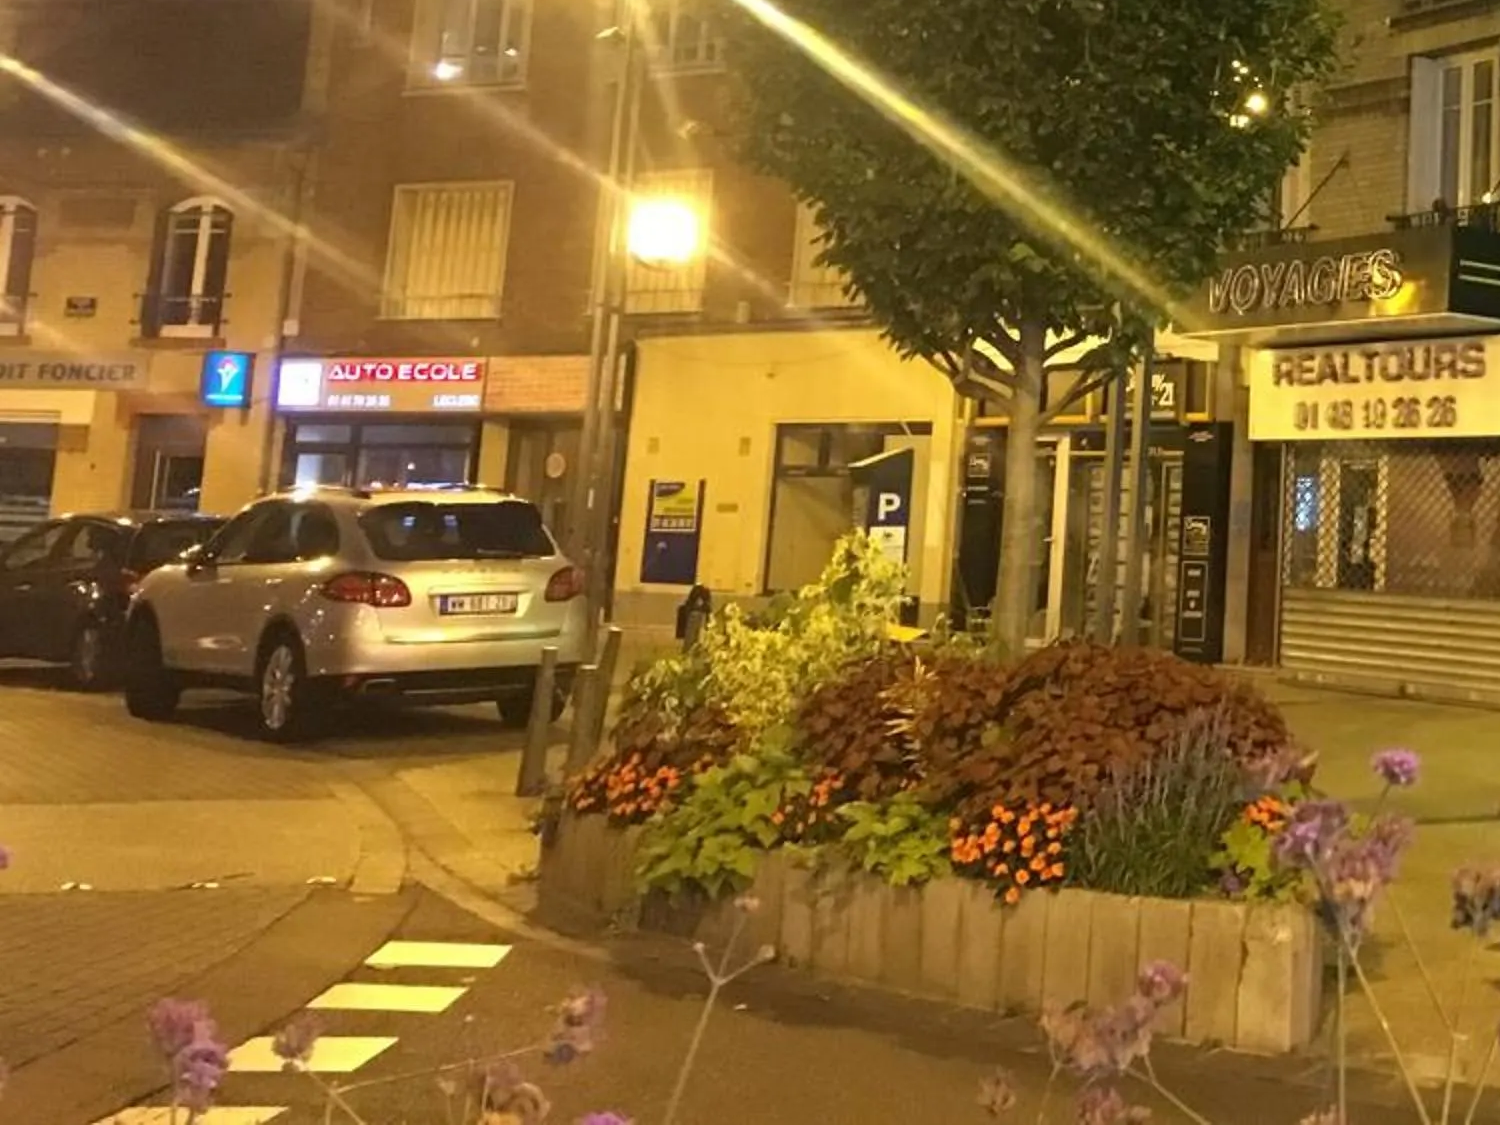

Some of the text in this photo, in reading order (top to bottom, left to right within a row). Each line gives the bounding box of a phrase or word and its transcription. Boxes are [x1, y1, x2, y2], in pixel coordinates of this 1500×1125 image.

[37, 362, 136, 381] FONCIER
[328, 362, 478, 380] AUTO ECOLE
[877, 492, 901, 522] P
